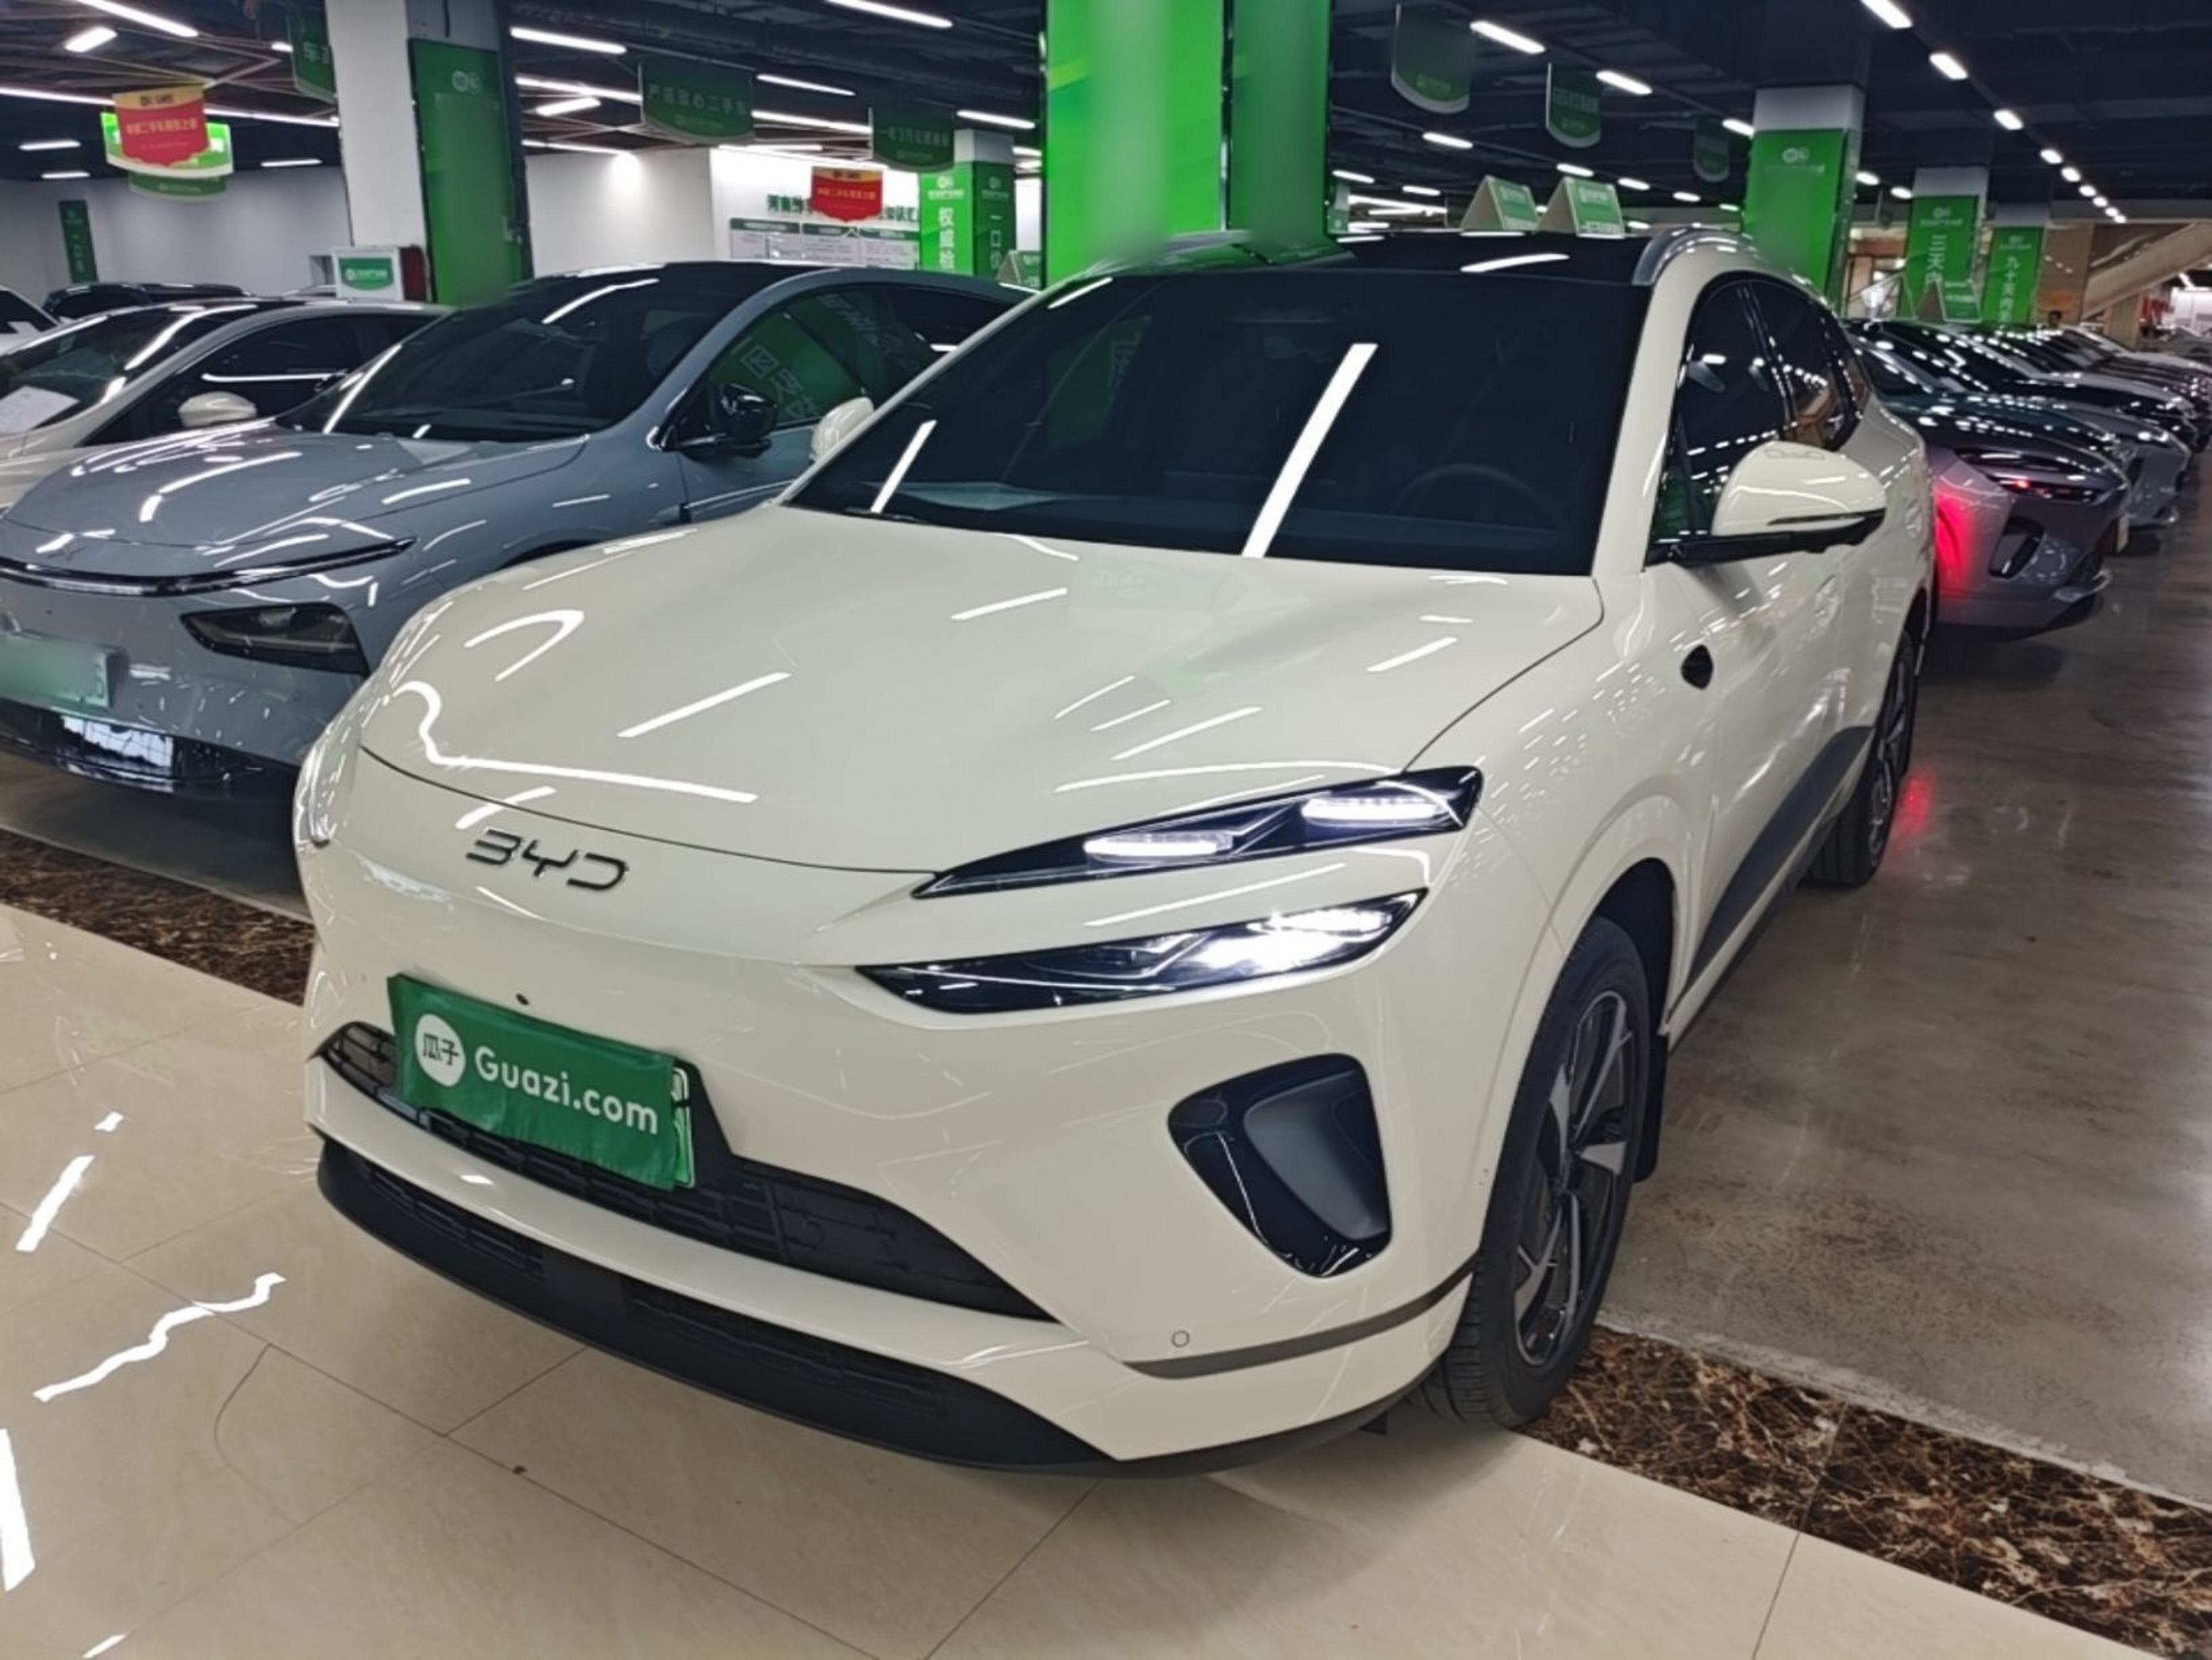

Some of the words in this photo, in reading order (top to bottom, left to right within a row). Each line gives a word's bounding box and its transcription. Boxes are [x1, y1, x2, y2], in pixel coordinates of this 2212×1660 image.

[465, 829, 630, 891] BYD
[423, 1033, 460, 1067] 瓜子
[475, 1046, 658, 1135] Guazi.com
